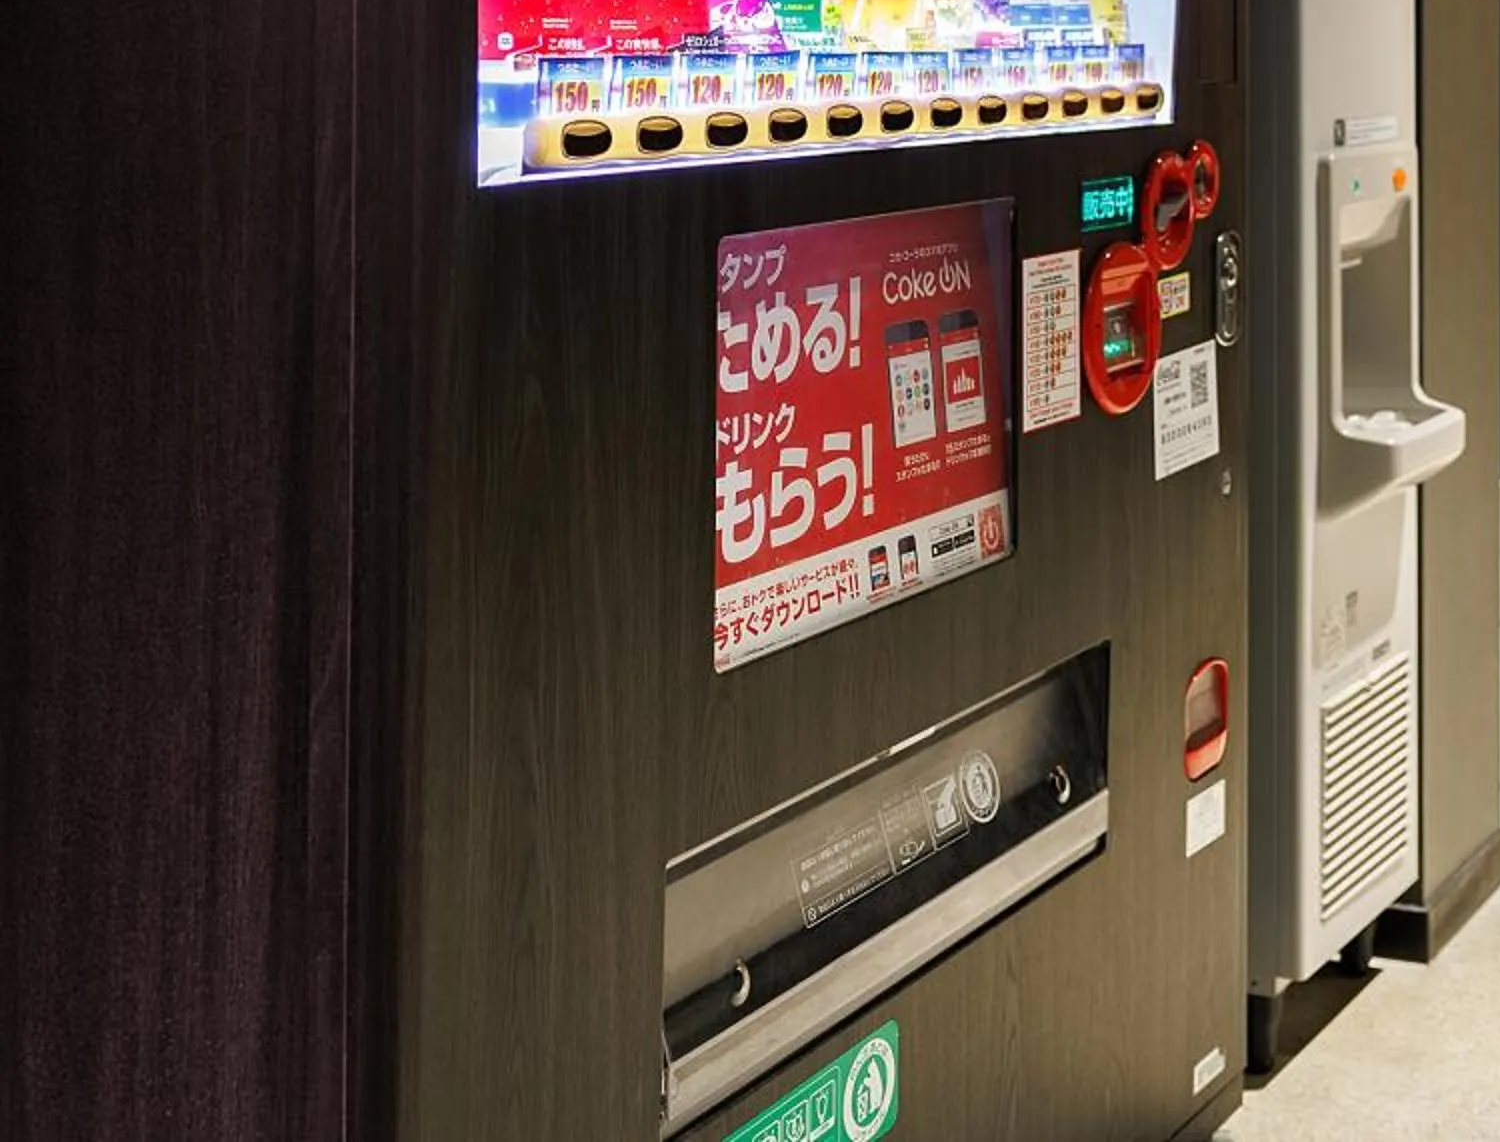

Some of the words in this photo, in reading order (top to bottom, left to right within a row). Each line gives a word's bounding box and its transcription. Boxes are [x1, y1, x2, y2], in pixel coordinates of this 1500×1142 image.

[1083, 186, 1129, 222] 販売中
[719, 244, 786, 294] タンプ
[883, 267, 937, 304] Coke
[939, 256, 972, 292] ON
